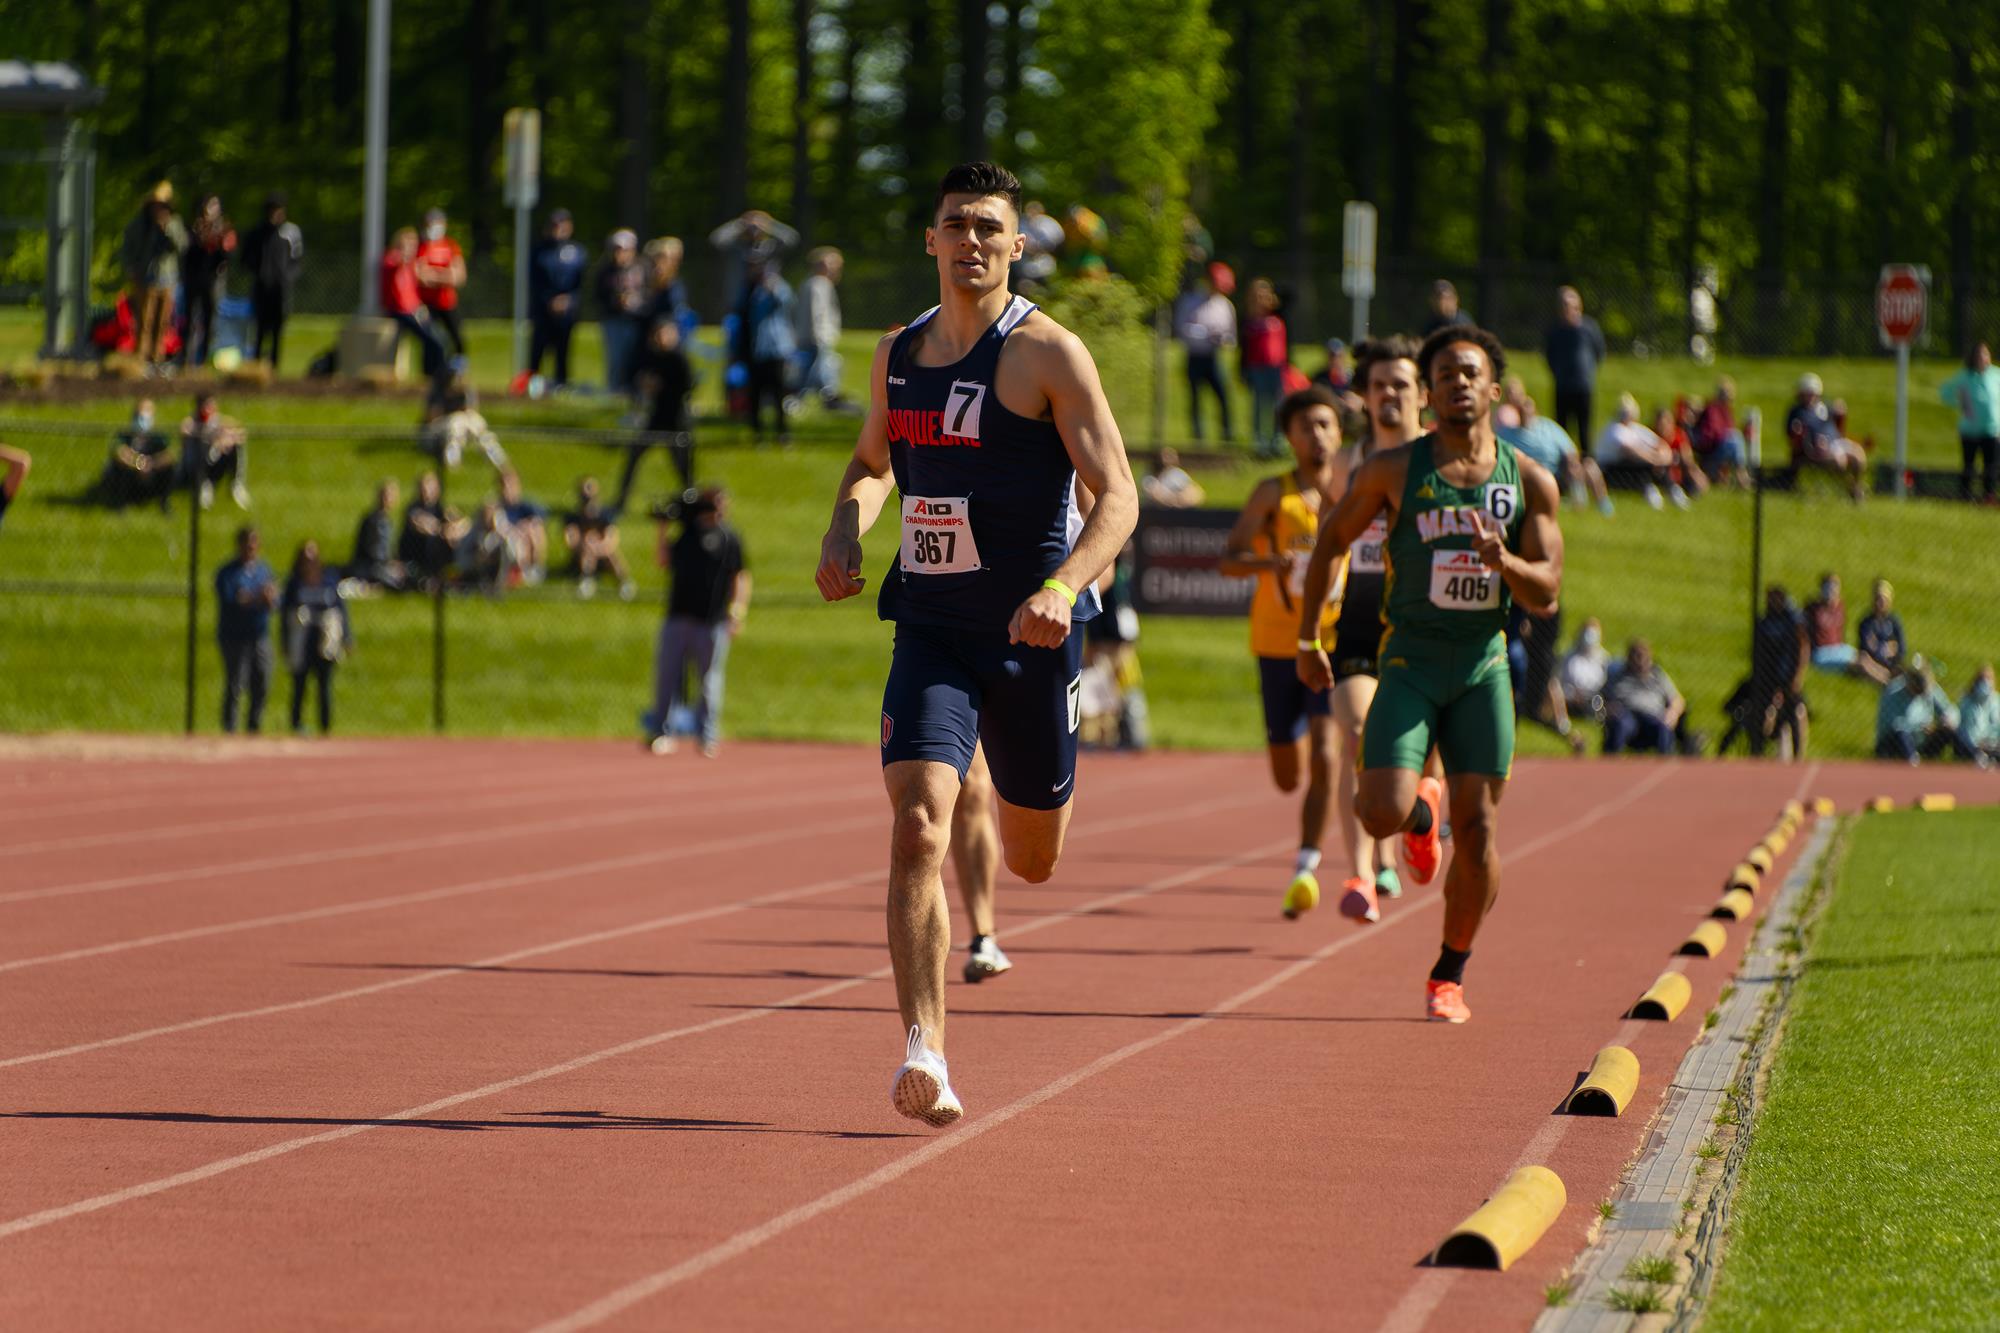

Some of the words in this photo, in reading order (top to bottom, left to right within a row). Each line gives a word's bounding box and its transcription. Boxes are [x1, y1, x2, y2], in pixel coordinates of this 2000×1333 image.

[952, 385, 980, 433] 7
[905, 515, 964, 527] CHAMPIONSHIPS
[913, 499, 953, 516] A10
[1491, 487, 1512, 520] 6
[1416, 505, 1504, 543] MAS
[913, 529, 957, 566] 367
[1444, 576, 1490, 603] 405
[1069, 679, 1080, 727] 7
